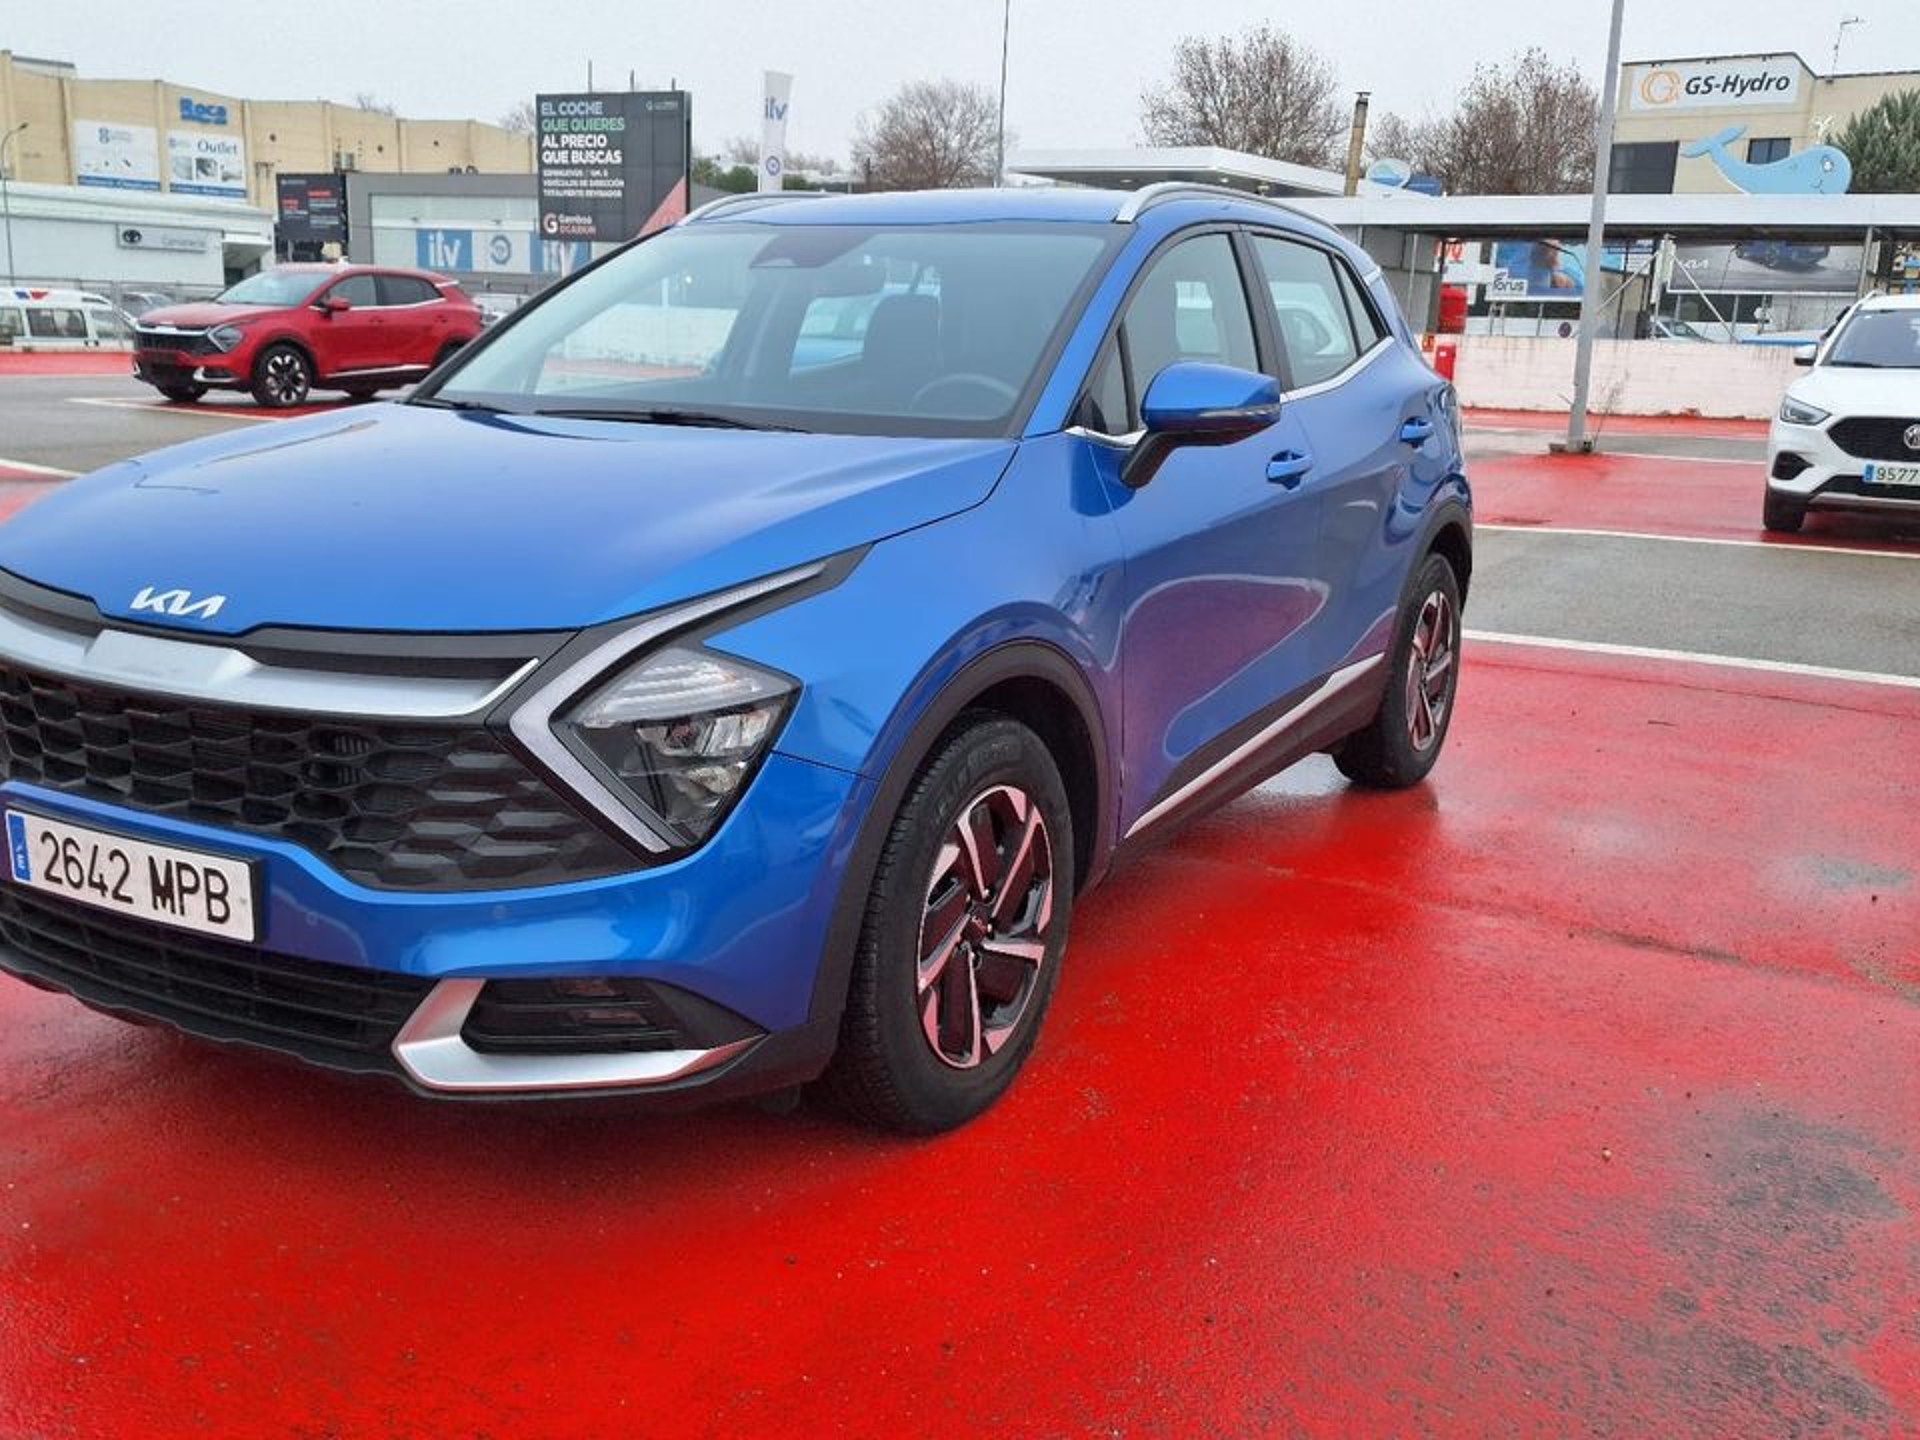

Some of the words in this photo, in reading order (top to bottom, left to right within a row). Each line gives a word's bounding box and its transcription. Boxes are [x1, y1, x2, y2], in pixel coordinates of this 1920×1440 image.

[1685, 72, 1791, 98] GS-Hydro
[541, 101, 556, 115] EL
[558, 101, 603, 115] COCHE
[541, 118, 569, 132] QUE
[570, 117, 625, 131] QUIERES
[197, 138, 238, 155] Outlet
[542, 134, 559, 148] AL
[561, 134, 608, 148] PRECIO
[542, 150, 569, 164] QUE
[571, 150, 623, 164] BUSCAS
[1876, 467, 1919, 482] 9577
[40, 831, 134, 905] 2642
[147, 855, 231, 925] MPB
